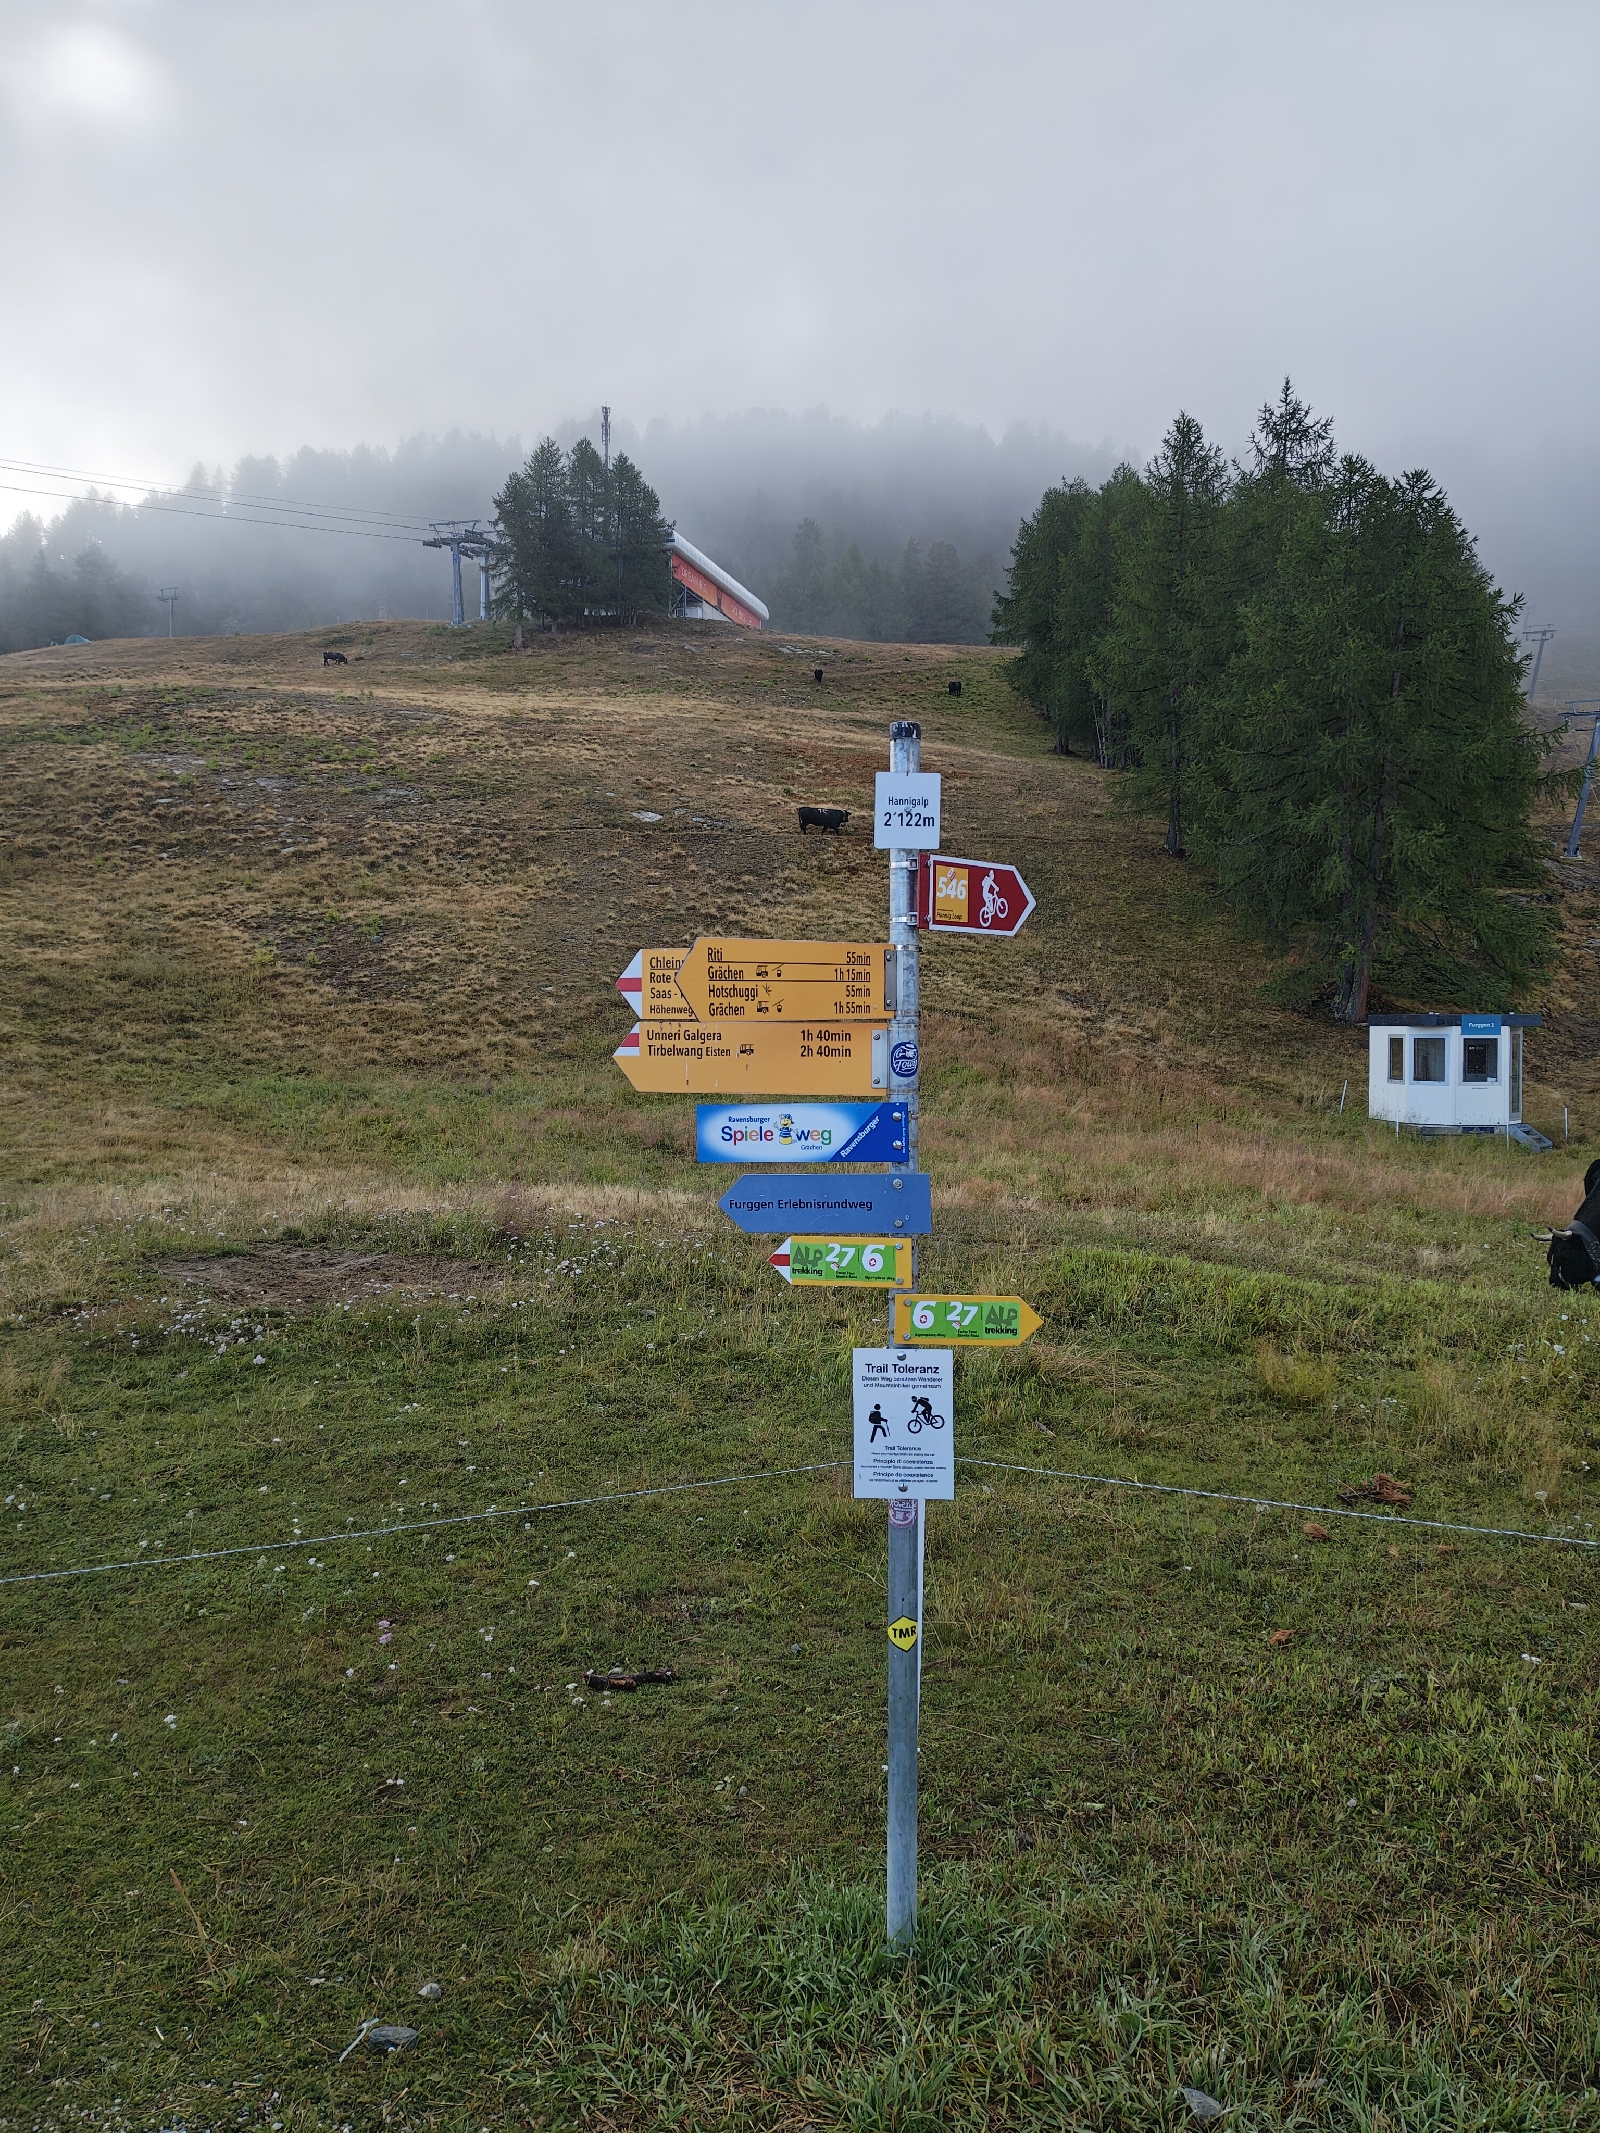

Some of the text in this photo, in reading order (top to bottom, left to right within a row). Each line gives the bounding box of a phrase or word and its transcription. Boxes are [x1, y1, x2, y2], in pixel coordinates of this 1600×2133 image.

[888, 796, 929, 808] Hannigalp
[936, 876, 967, 900] 546
[708, 948, 870, 964] Riti 55min
[650, 972, 672, 984] Rote
[708, 966, 870, 982] Grächen 1h 15min
[650, 988, 672, 998] Saas
[708, 984, 870, 1000] Hotschuggi 55min
[650, 1004, 693, 1017] Höhenweg
[708, 1002, 870, 1016] Grächen 1h 55min
[646, 1030, 851, 1044] Unneri Galgera 1h 40min
[647, 1044, 851, 1059] Tirbelwang Eisten 2h 40min
[728, 1116, 770, 1124] Ravensburger
[721, 1125, 832, 1146] Spiele weg
[840, 1115, 881, 1158] Ravensburger
[730, 1198, 872, 1212] Furggen Erlebnisrundweg
[792, 1245, 822, 1268] ALP
[826, 1243, 856, 1267] 27
[862, 1244, 886, 1272] 6
[792, 1266, 822, 1276] trekking
[912, 1300, 936, 1330] 6
[946, 1301, 978, 1326] 27
[985, 1304, 1018, 1326] ALP
[985, 1326, 1018, 1336] trekking
[865, 1364, 940, 1374] Trail Toleranz
